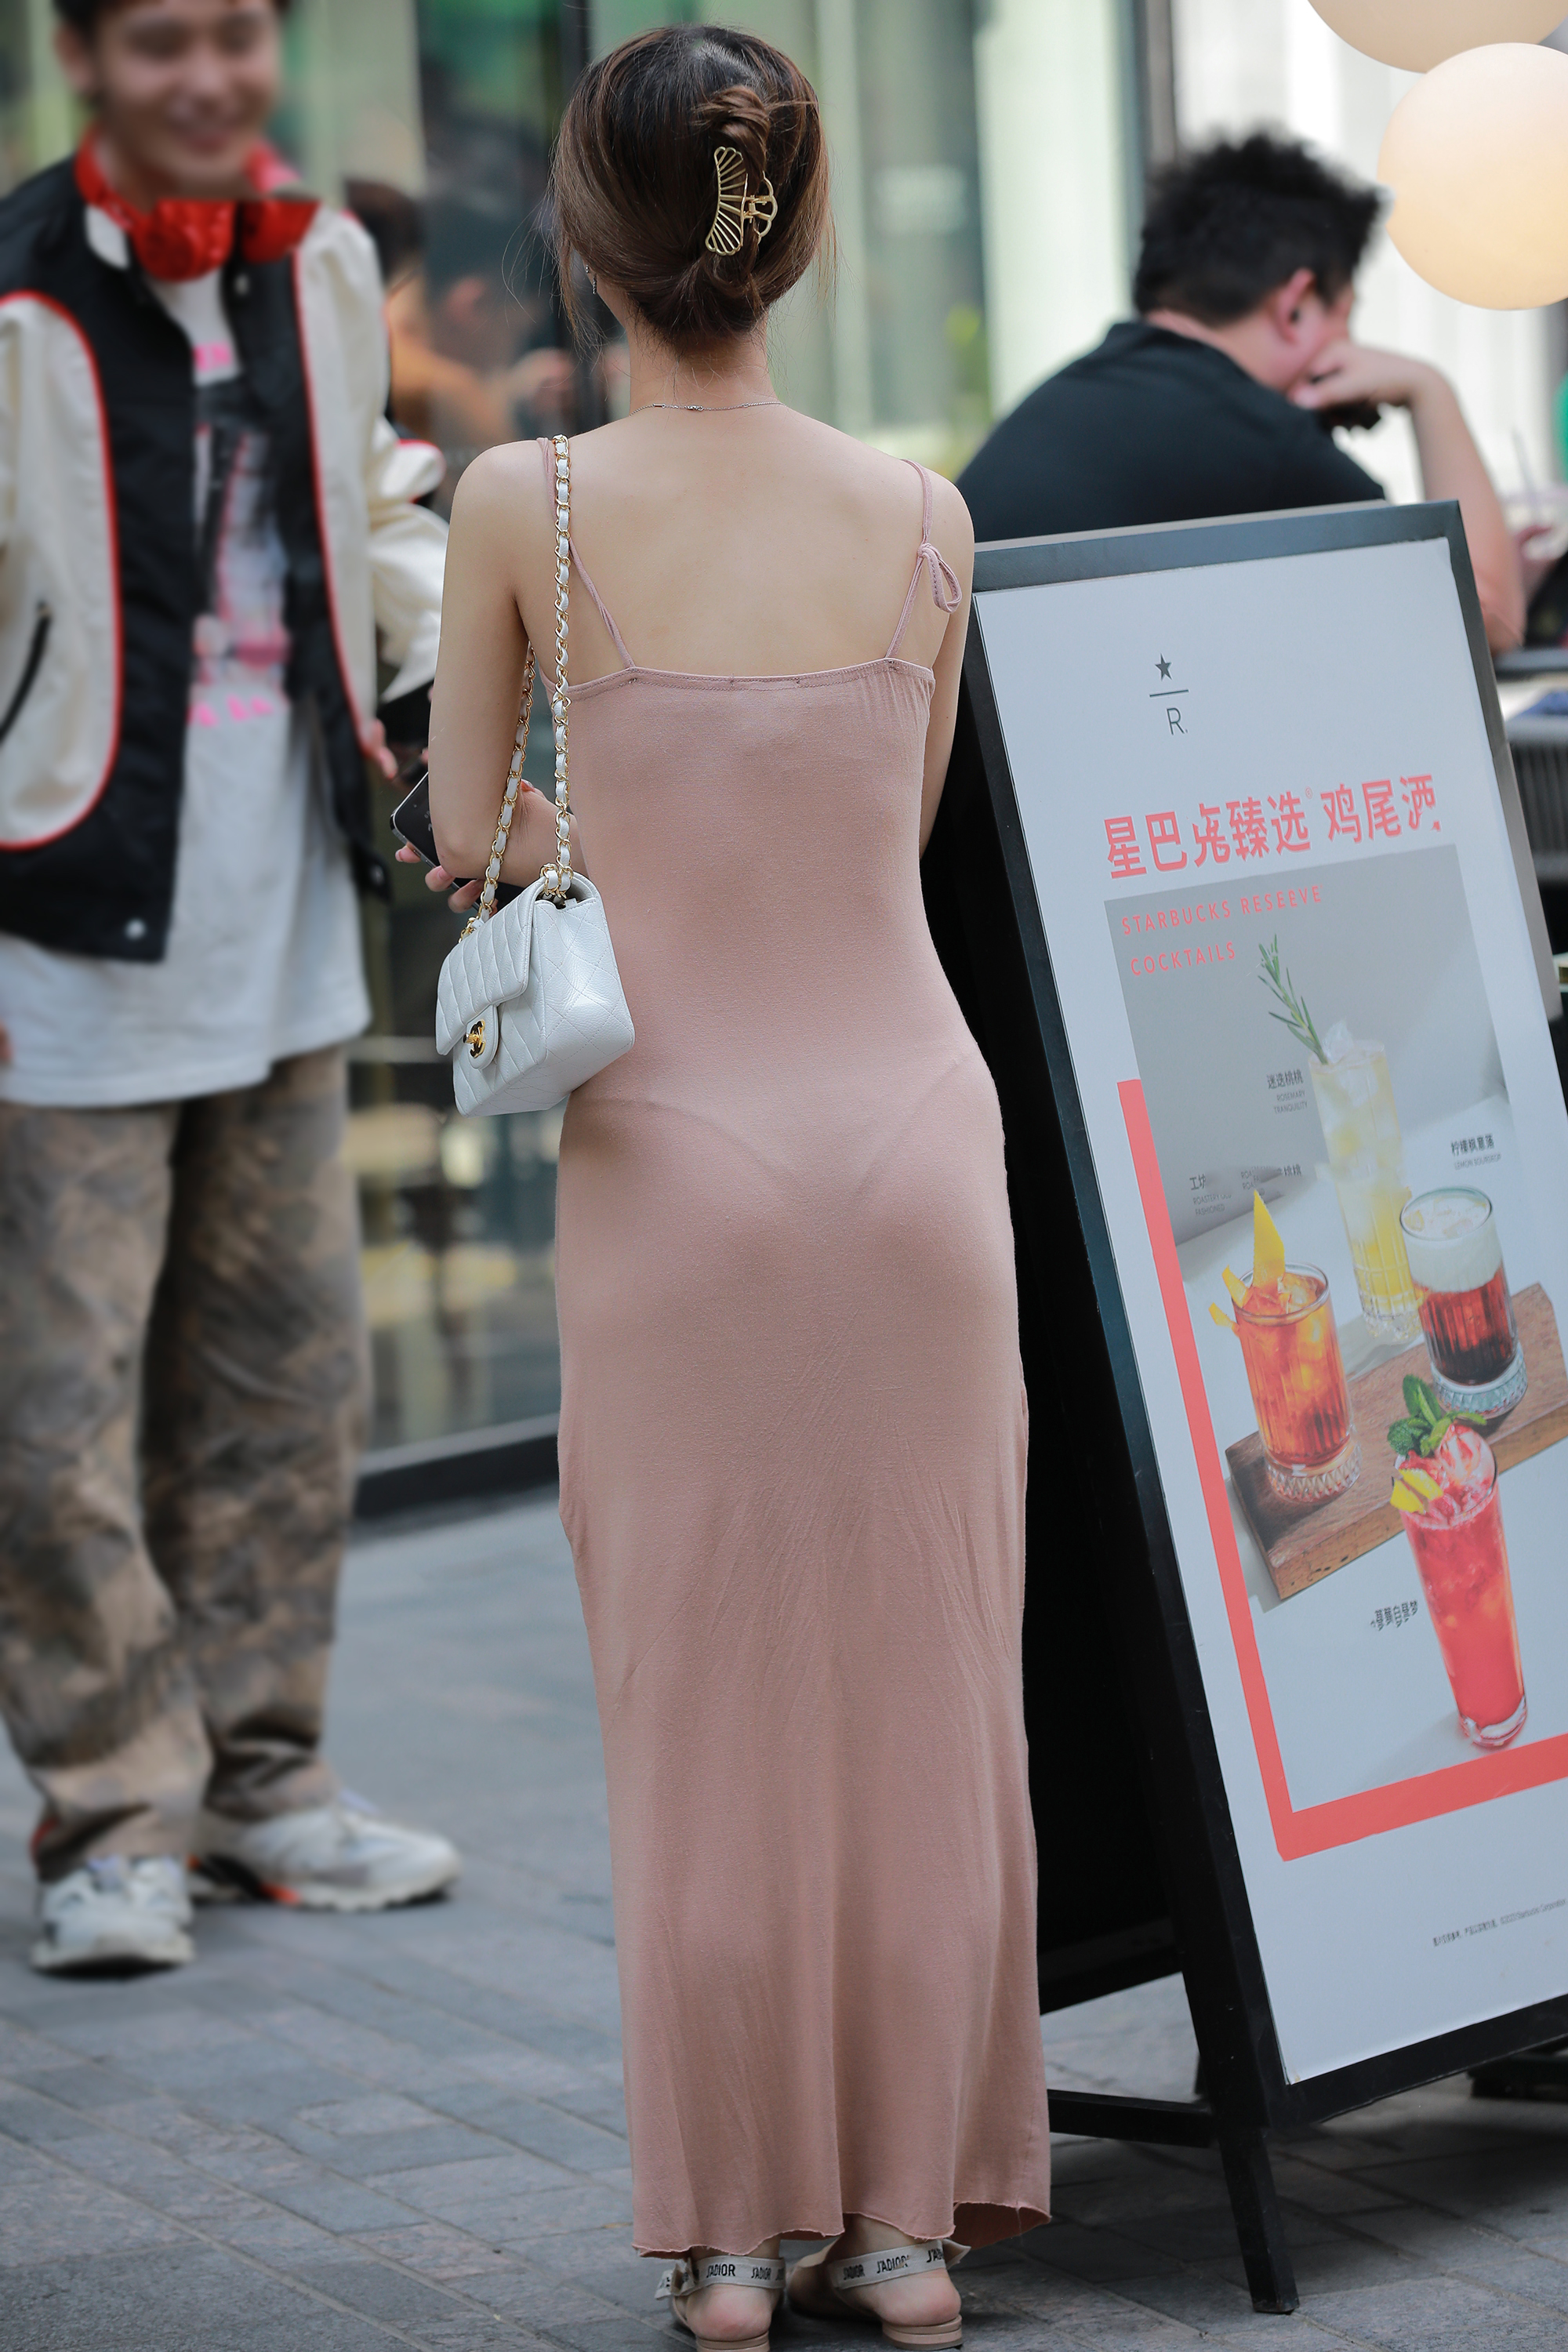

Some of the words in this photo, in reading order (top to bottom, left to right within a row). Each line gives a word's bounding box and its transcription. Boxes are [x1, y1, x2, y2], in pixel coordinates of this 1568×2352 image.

[1167, 708, 1185, 735] R
[1122, 900, 1231, 935] STARBUCKS
[1131, 942, 1236, 976] COCKTAILS
